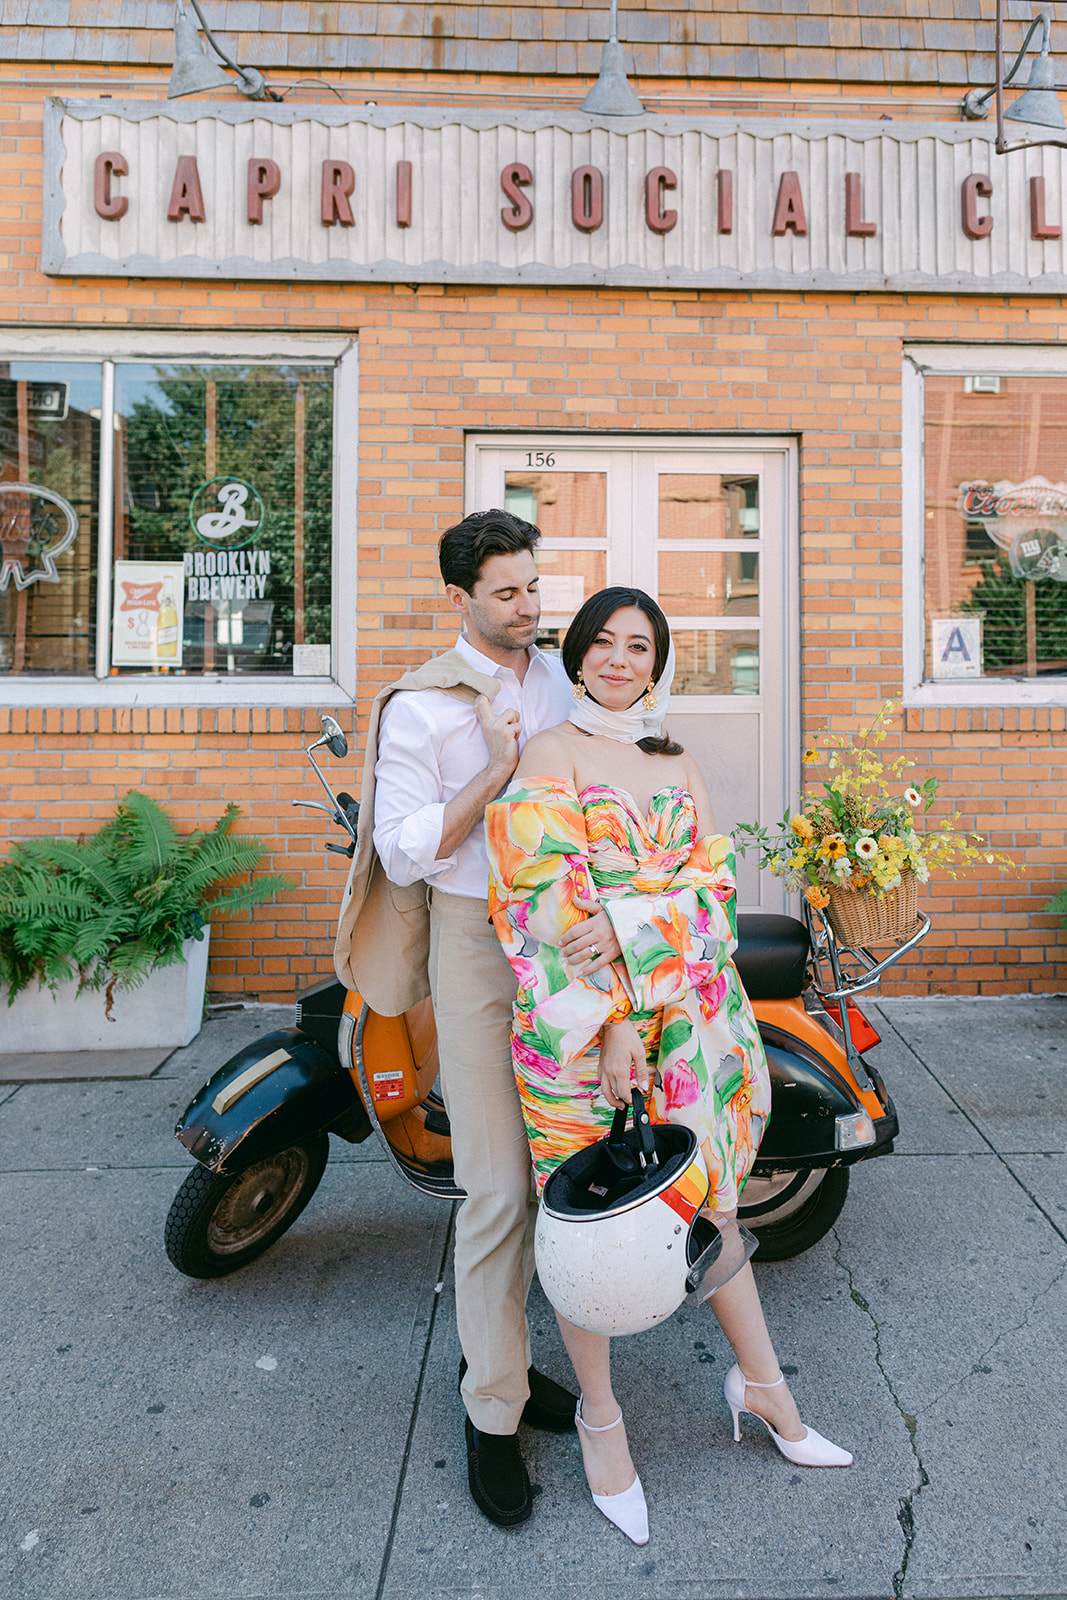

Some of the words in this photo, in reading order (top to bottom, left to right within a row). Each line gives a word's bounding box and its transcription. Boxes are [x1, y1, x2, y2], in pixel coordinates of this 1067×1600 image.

[94, 151, 413, 229] CAPRI
[500, 162, 877, 238] SOCIAL
[961, 173, 1062, 241] CL
[525, 452, 555, 467] 156
[196, 483, 259, 538] B
[183, 550, 271, 577] BROOKLYN
[188, 575, 267, 601] BREWERY
[941, 626, 971, 661] A
